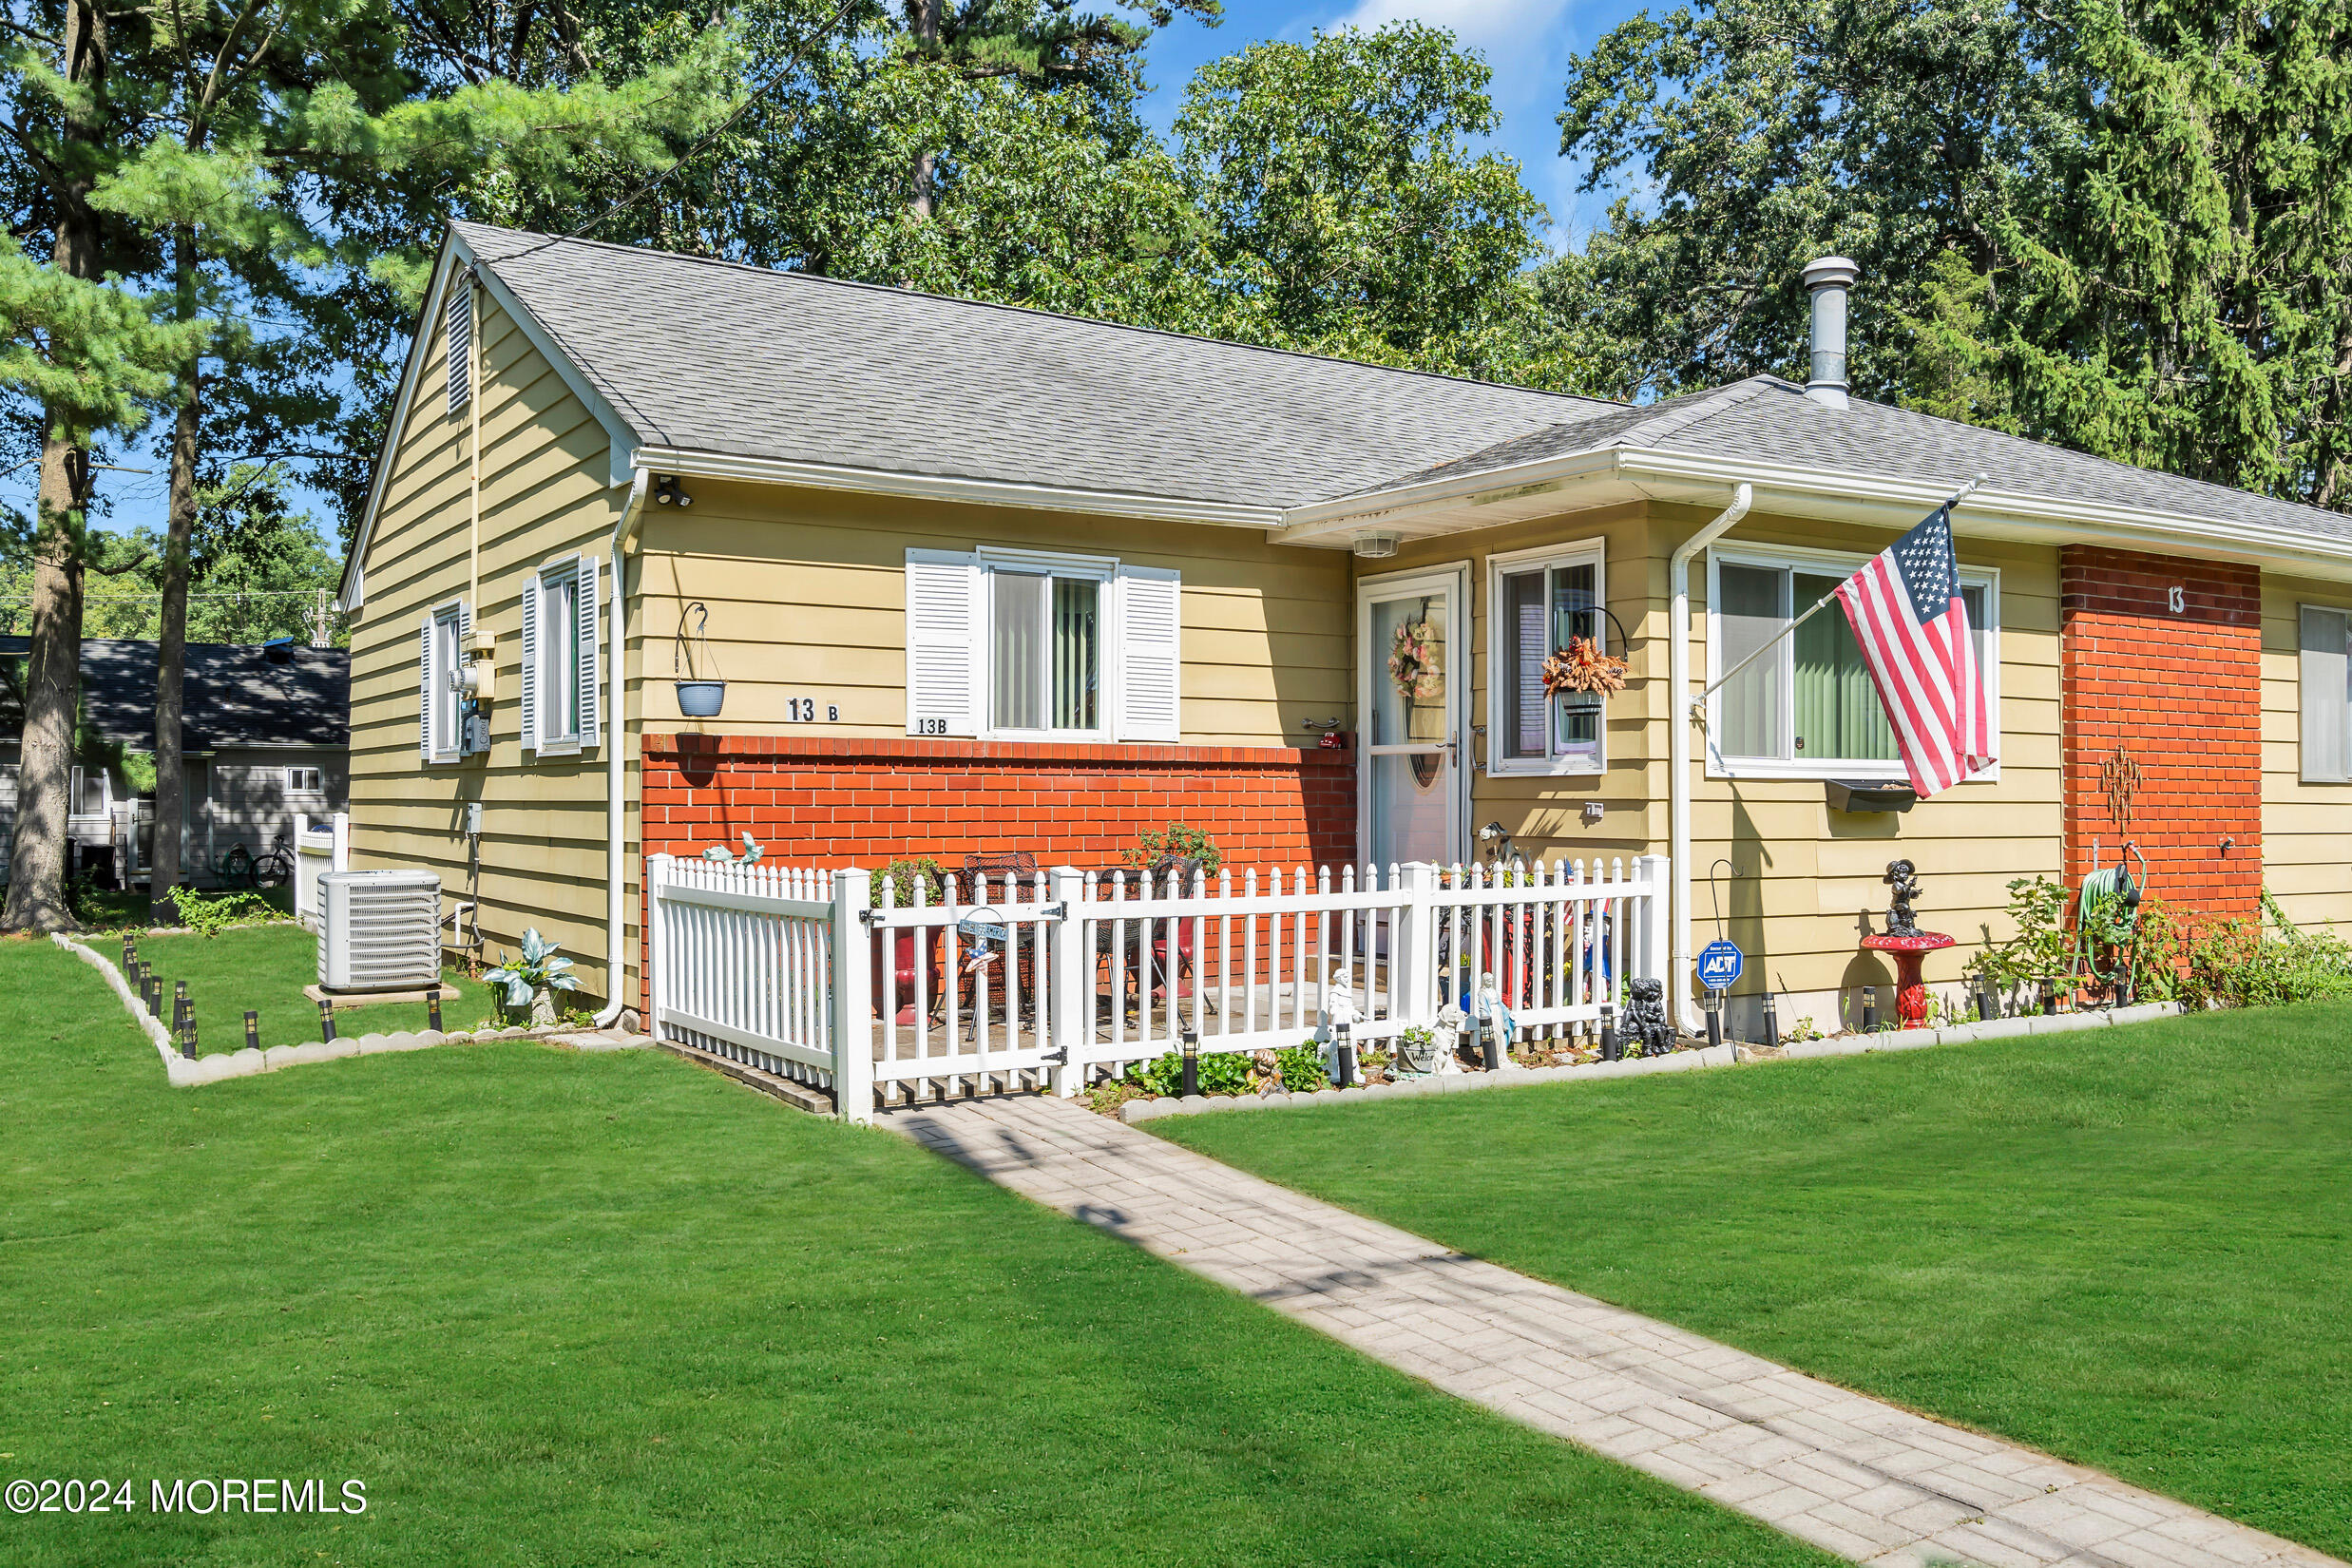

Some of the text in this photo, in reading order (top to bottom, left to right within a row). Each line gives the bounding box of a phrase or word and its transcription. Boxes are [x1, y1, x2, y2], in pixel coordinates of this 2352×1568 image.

[2168, 585, 2185, 613] 13
[789, 698, 838, 721] 13 B
[918, 718, 947, 734] 13B
[1705, 956, 1736, 973] ADT
[1411, 1052, 1434, 1061] Welco
